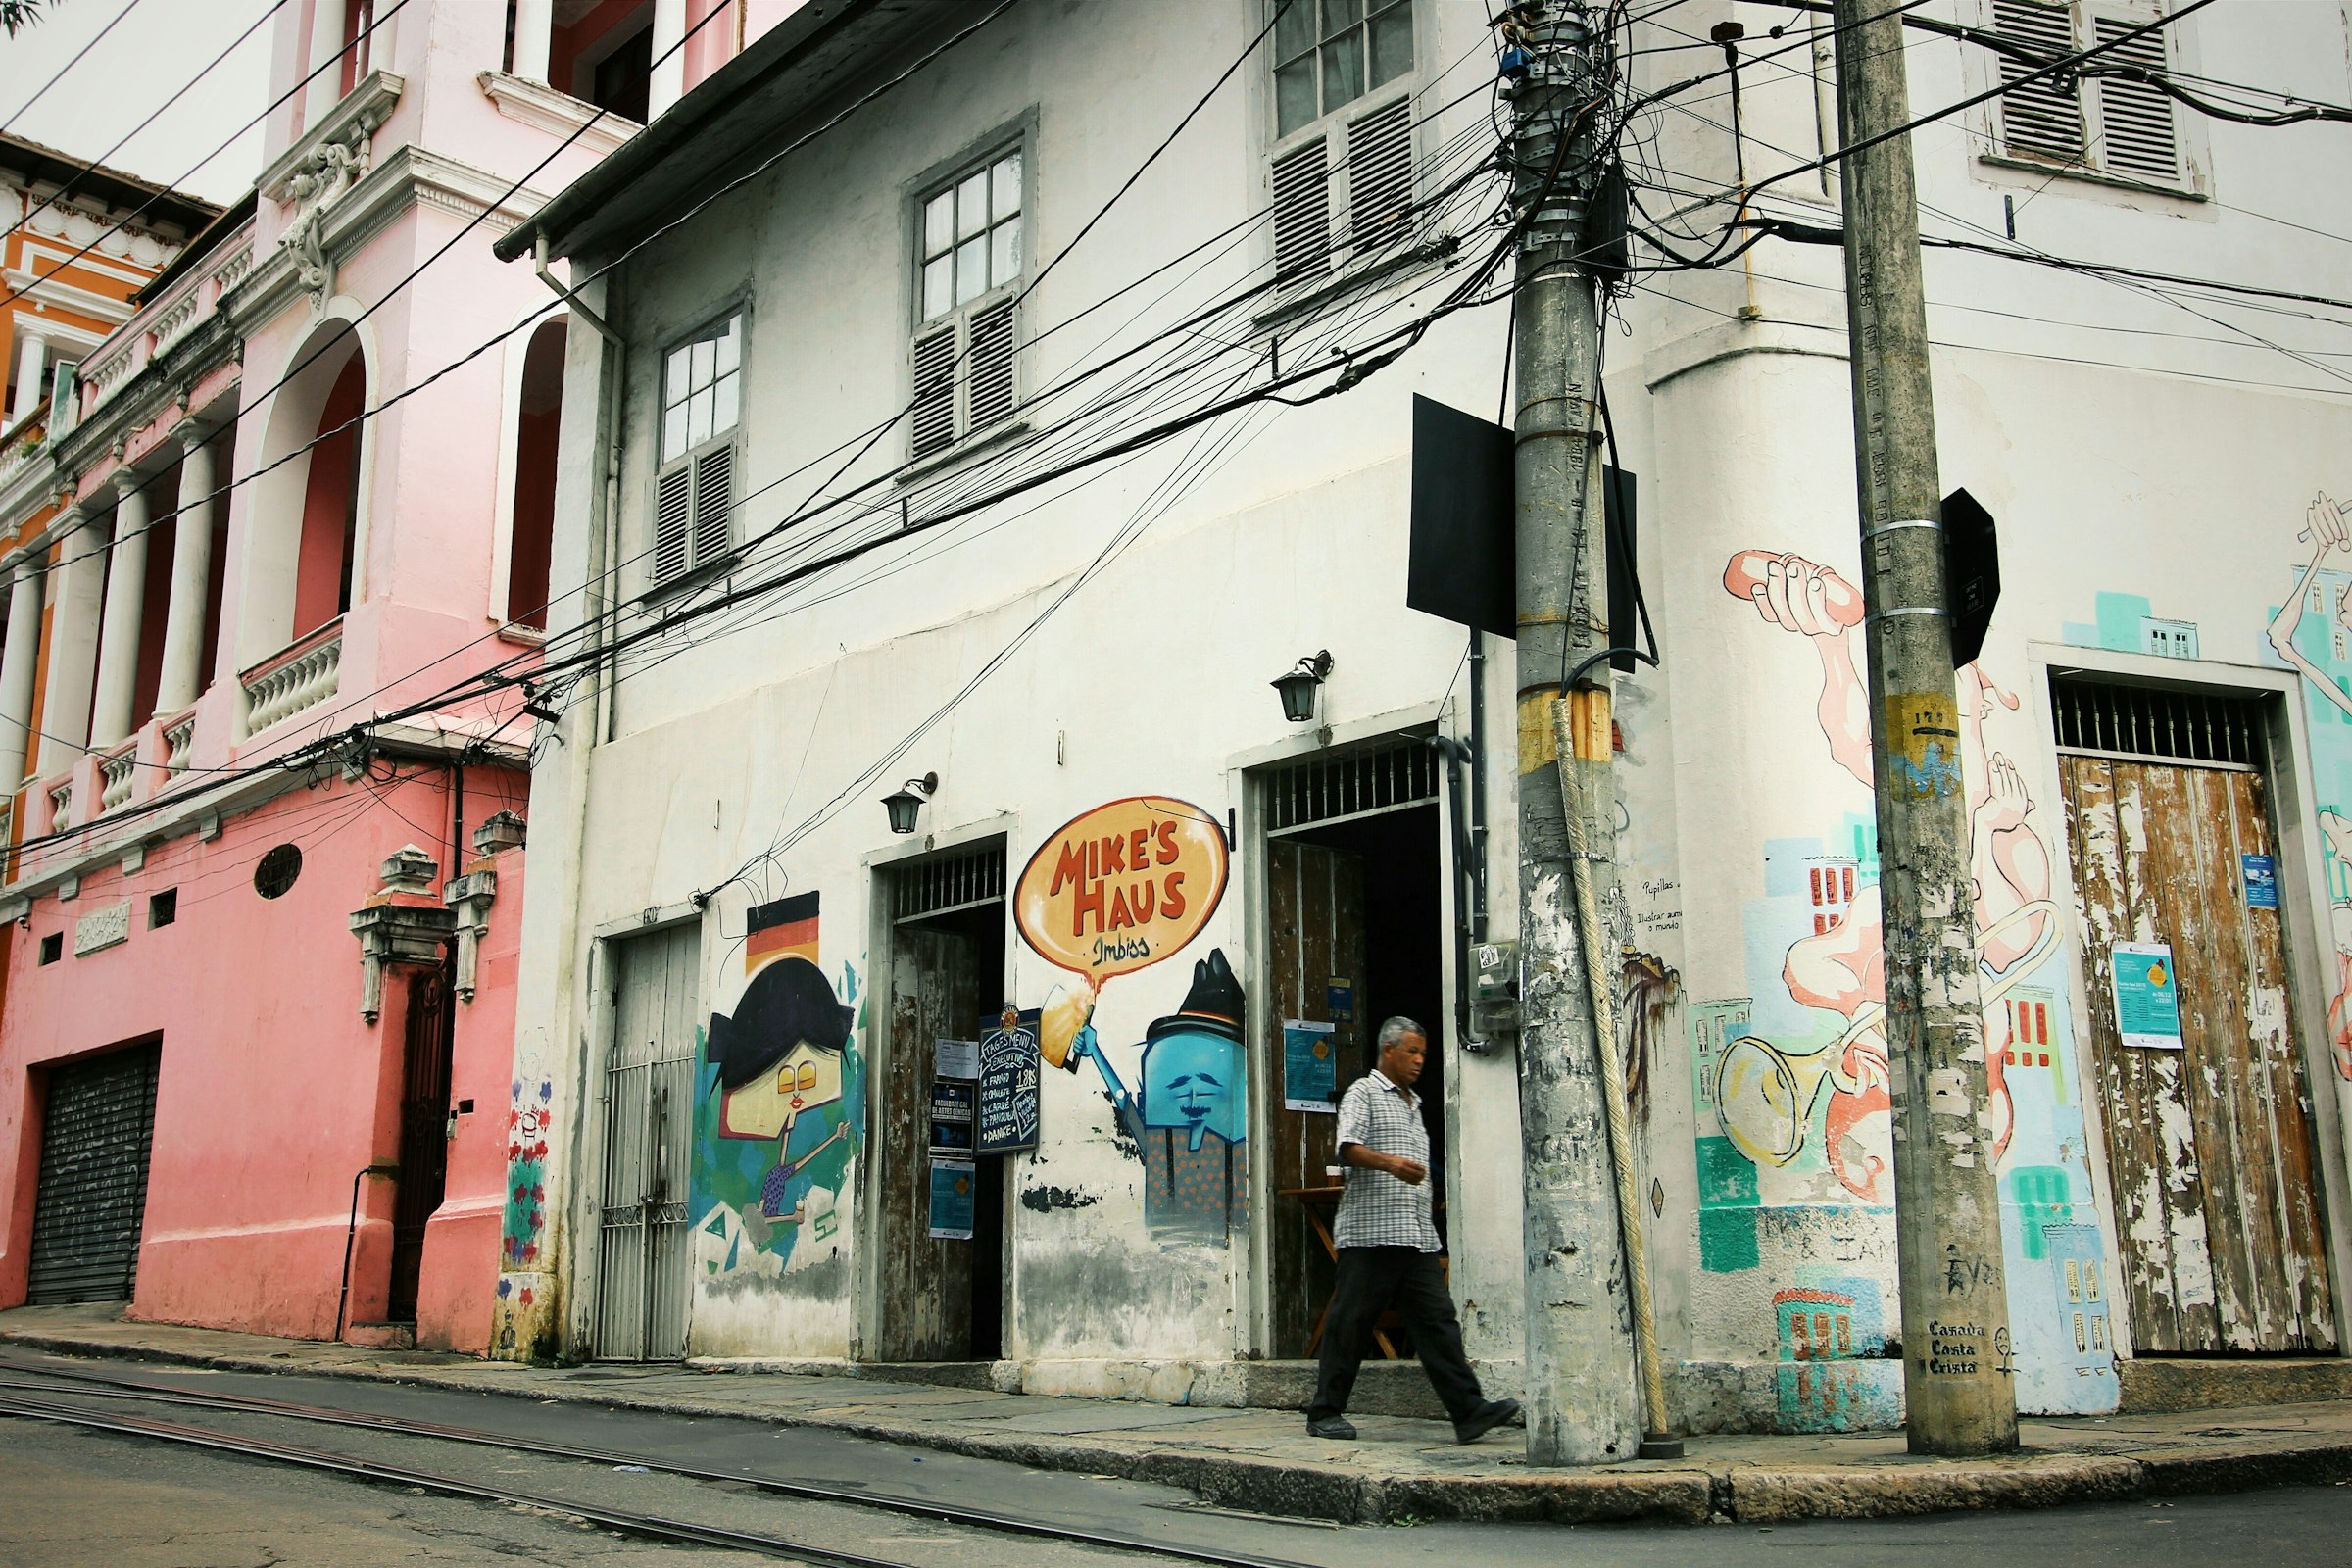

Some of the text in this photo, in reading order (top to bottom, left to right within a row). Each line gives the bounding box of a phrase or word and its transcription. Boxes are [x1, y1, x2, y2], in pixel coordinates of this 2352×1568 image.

[1050, 819, 1179, 897] MIKE'S
[1073, 871, 1186, 937] HAUS
[1092, 932, 1151, 966] Imbiss
[987, 1124, 1011, 1144] DANKE
[1931, 1339, 1977, 1356] Casta
